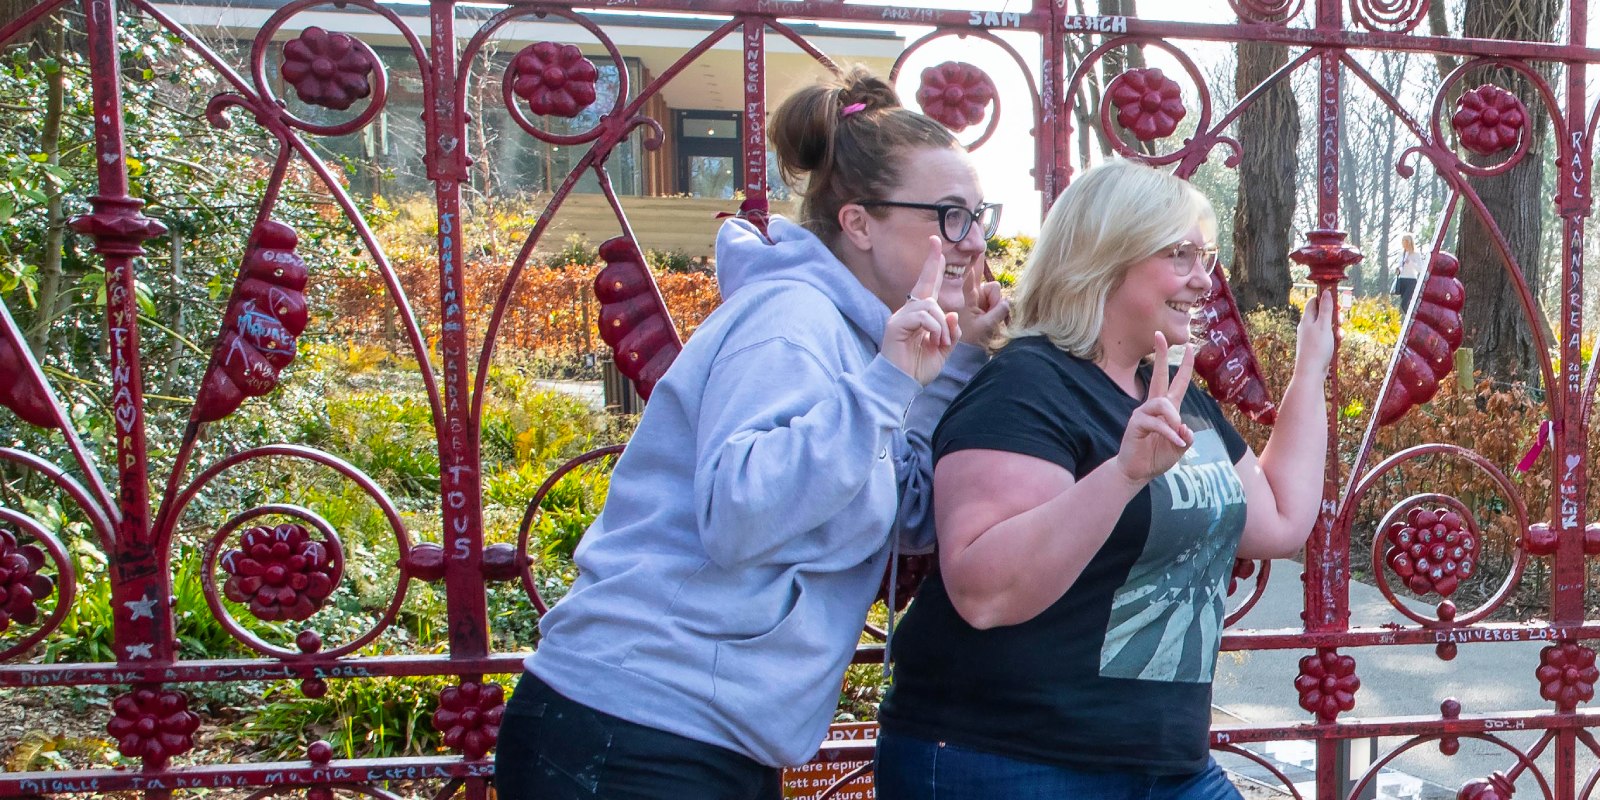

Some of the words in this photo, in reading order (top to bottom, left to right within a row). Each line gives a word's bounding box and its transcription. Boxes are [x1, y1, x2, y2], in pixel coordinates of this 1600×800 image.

[968, 11, 1021, 27] SAM
[1568, 229, 1582, 349] ANDREA
[1435, 629, 1520, 643] DANIVERGE
[812, 774, 836, 787] and
